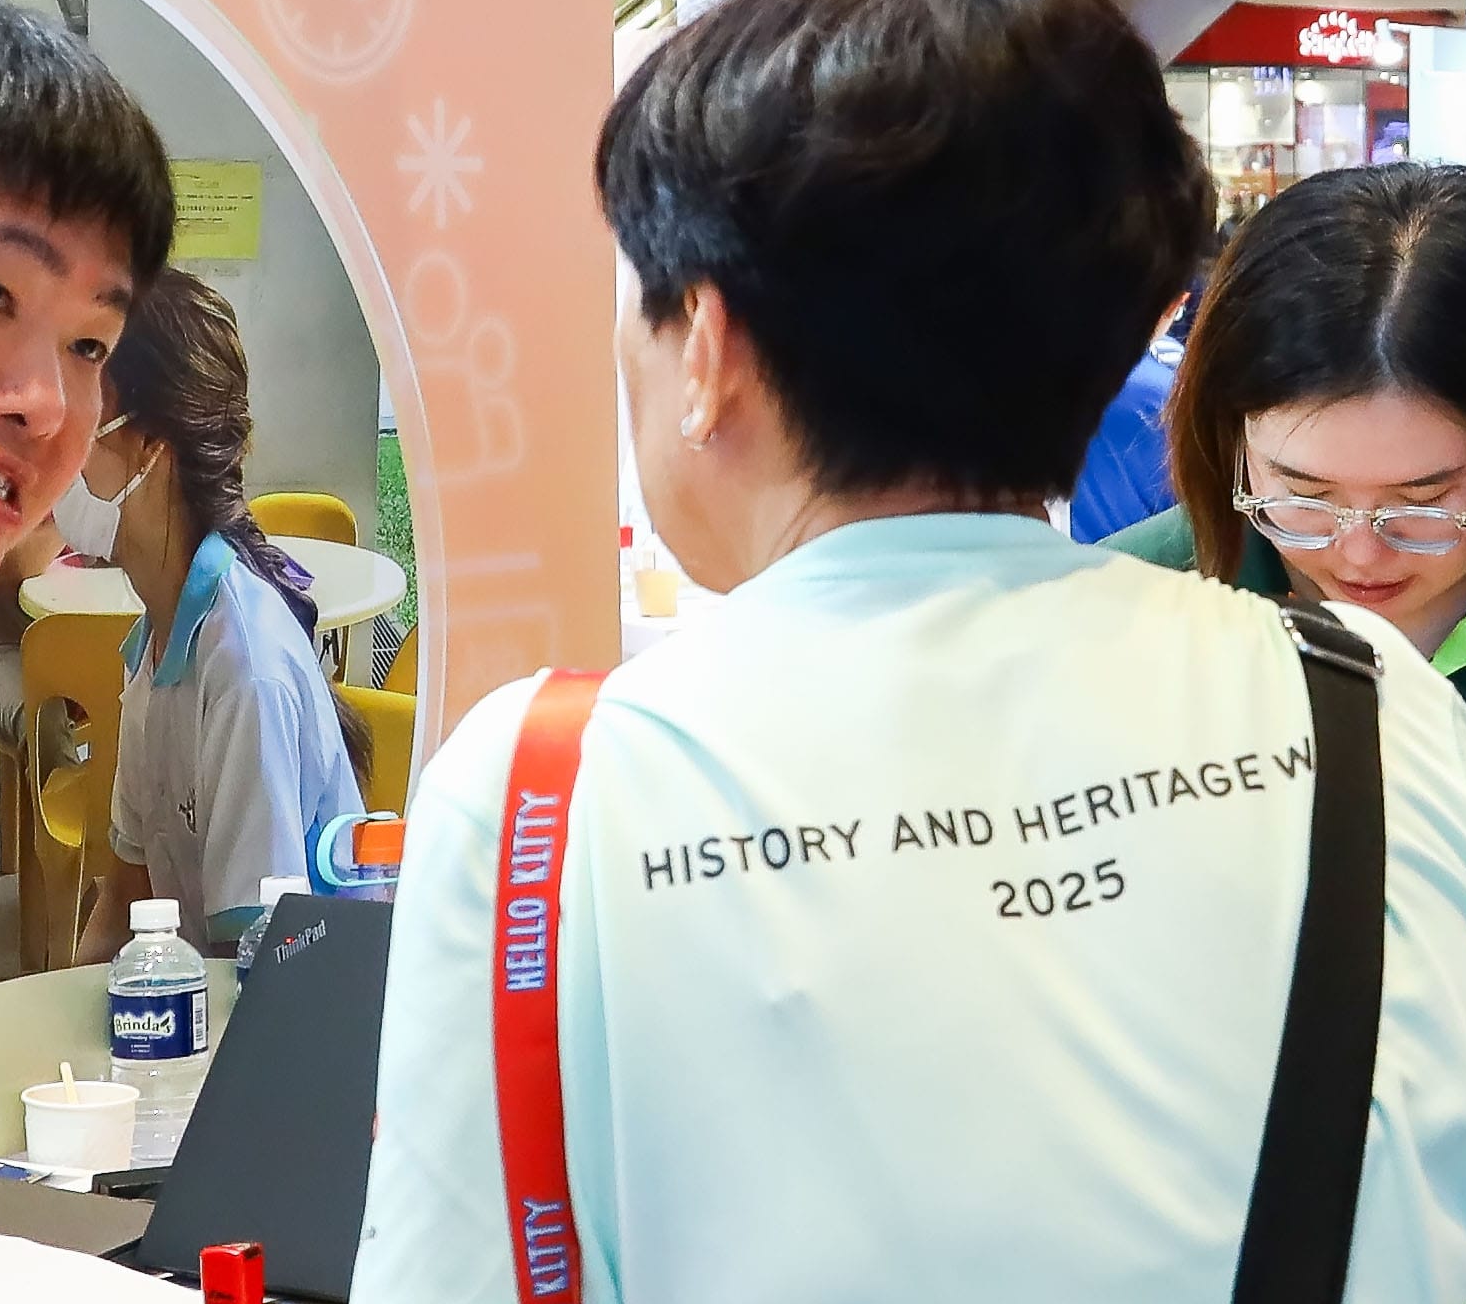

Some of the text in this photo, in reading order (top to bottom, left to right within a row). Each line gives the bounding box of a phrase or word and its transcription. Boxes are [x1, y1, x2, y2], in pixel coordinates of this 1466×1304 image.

[644, 818, 862, 889] HISTORY
[893, 807, 994, 852] AND
[1014, 752, 1267, 843] HERITAGE
[504, 789, 559, 993] HELLO KITTY
[991, 859, 1126, 918] 2025
[273, 918, 327, 965] ThinkPad
[114, 1011, 175, 1035] Brinda's
[522, 1199, 569, 1297] KITTY
